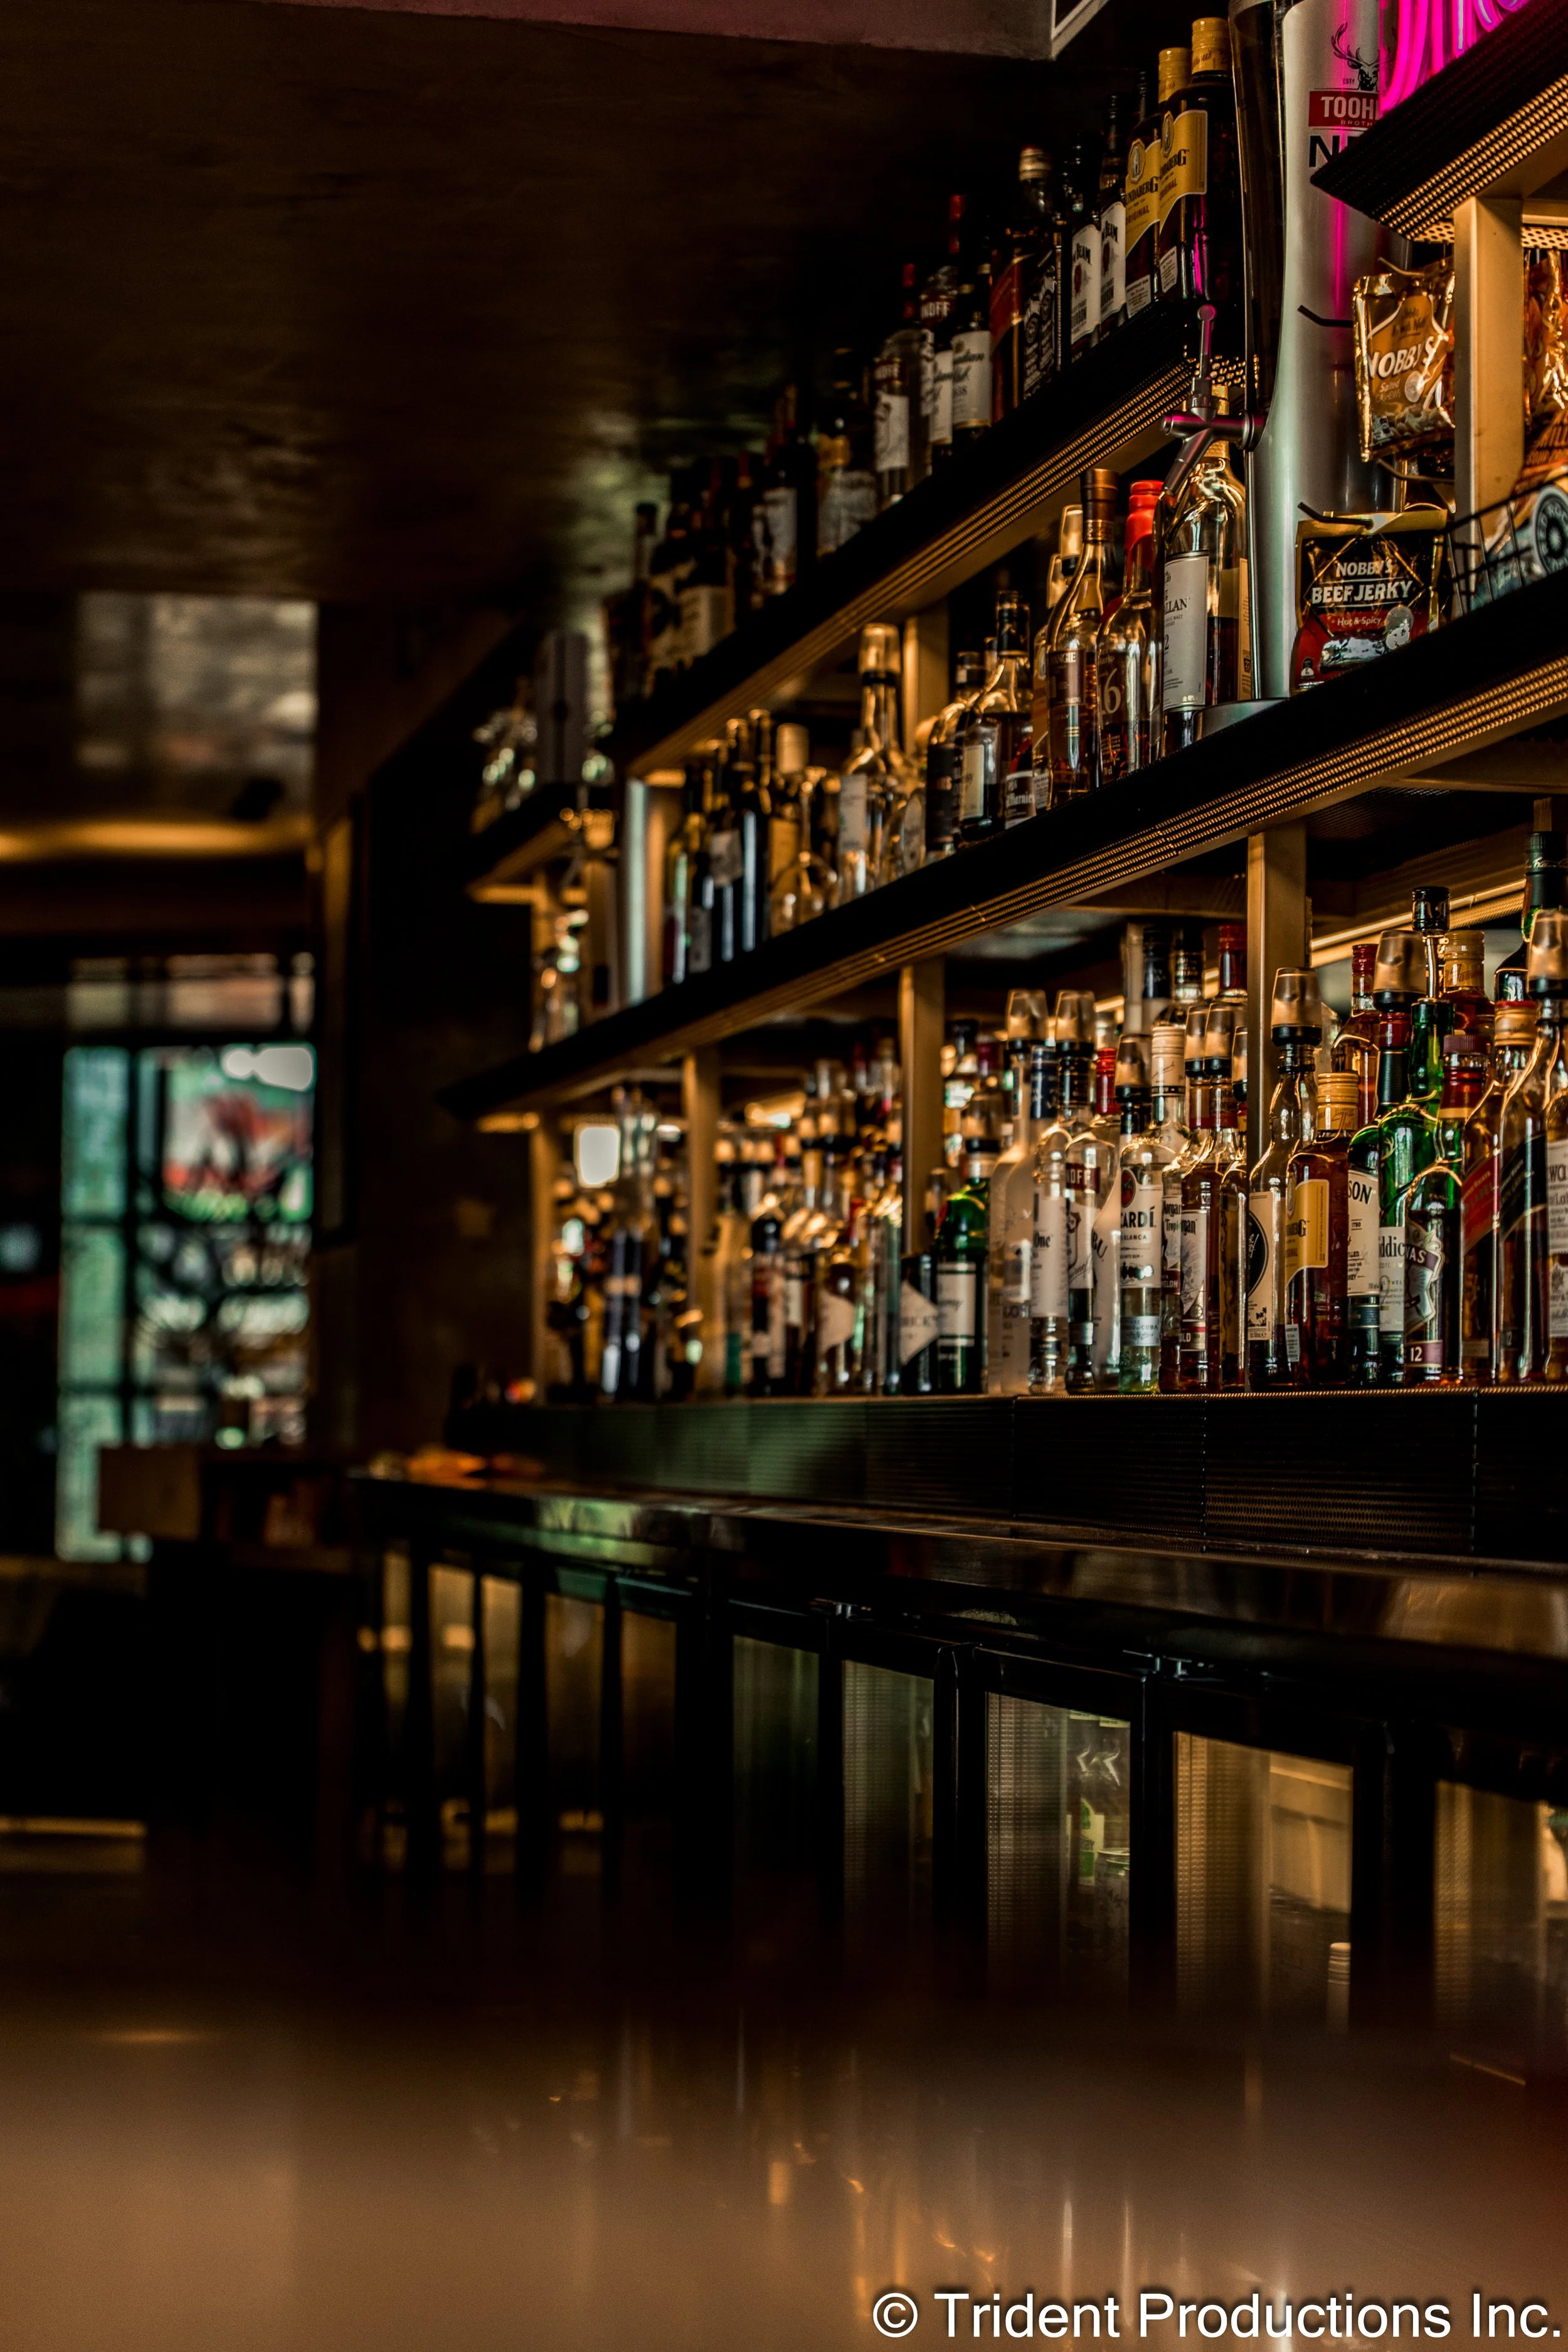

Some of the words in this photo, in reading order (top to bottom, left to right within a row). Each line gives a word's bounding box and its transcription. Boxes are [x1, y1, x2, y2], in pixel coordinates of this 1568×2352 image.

[1336, 556, 1393, 578] NOBBY'S
[1311, 586, 1354, 605] BEEF
[1353, 580, 1414, 602] JERKY
[1337, 617, 1353, 627] Hot
[1361, 615, 1382, 627] Spicy
[1121, 1205, 1155, 1228] ARDÍ
[1411, 1346, 1423, 1362] 12
